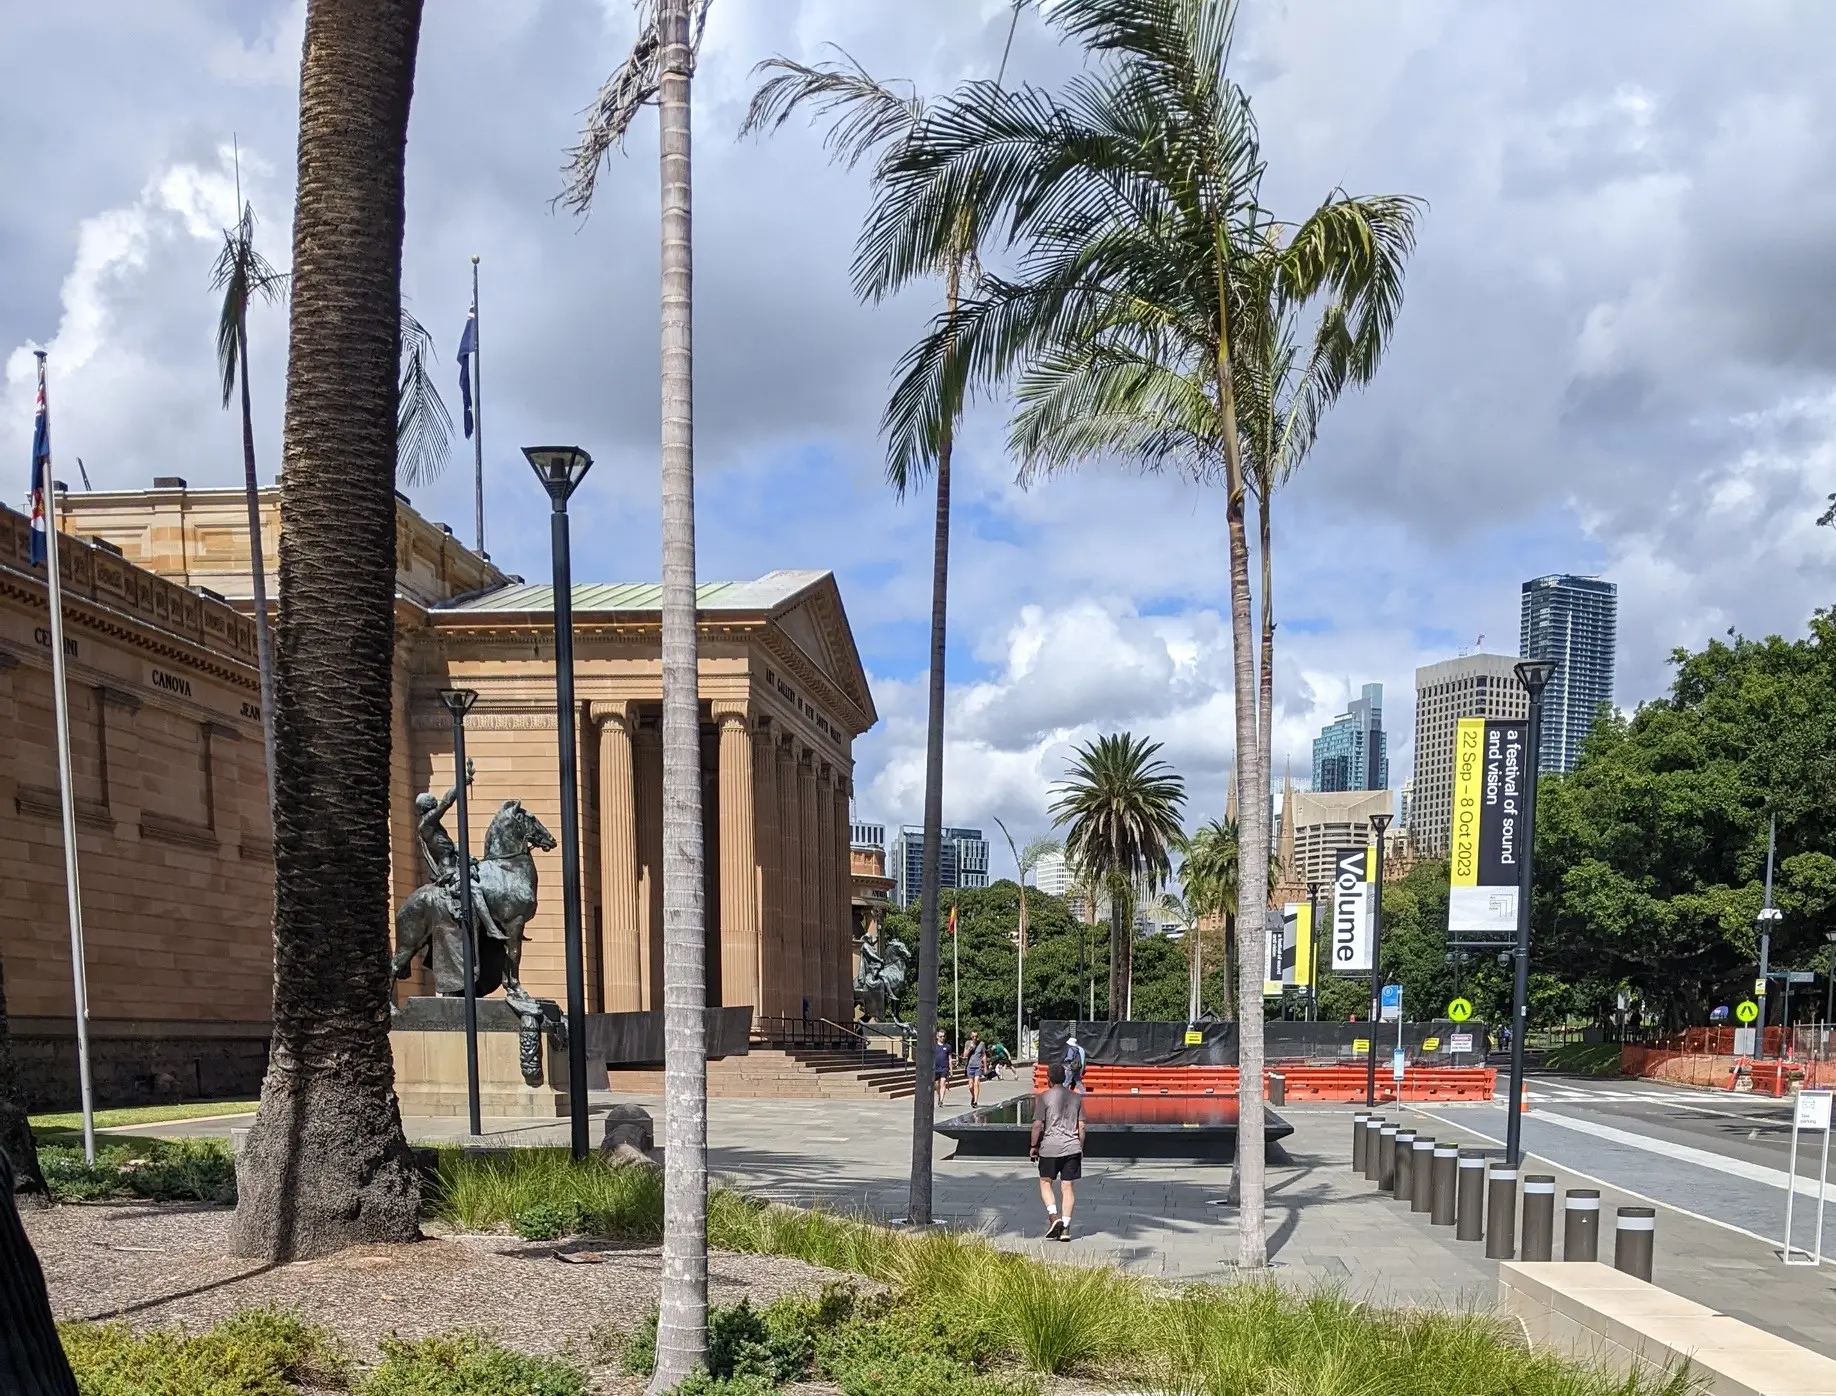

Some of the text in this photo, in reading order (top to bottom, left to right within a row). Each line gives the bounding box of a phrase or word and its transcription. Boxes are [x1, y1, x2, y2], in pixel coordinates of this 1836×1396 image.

[34, 627, 78, 658] CEINI
[151, 669, 192, 697] CANOVA
[1463, 731, 1477, 748] 22
[1460, 752, 1476, 781] Sep
[1486, 730, 1503, 805] and vision
[1460, 797, 1474, 807] 8
[1501, 730, 1521, 864] a festival of sound
[1459, 811, 1473, 838] Oct
[1457, 842, 1472, 877] 2023
[1336, 852, 1365, 962] Volume
